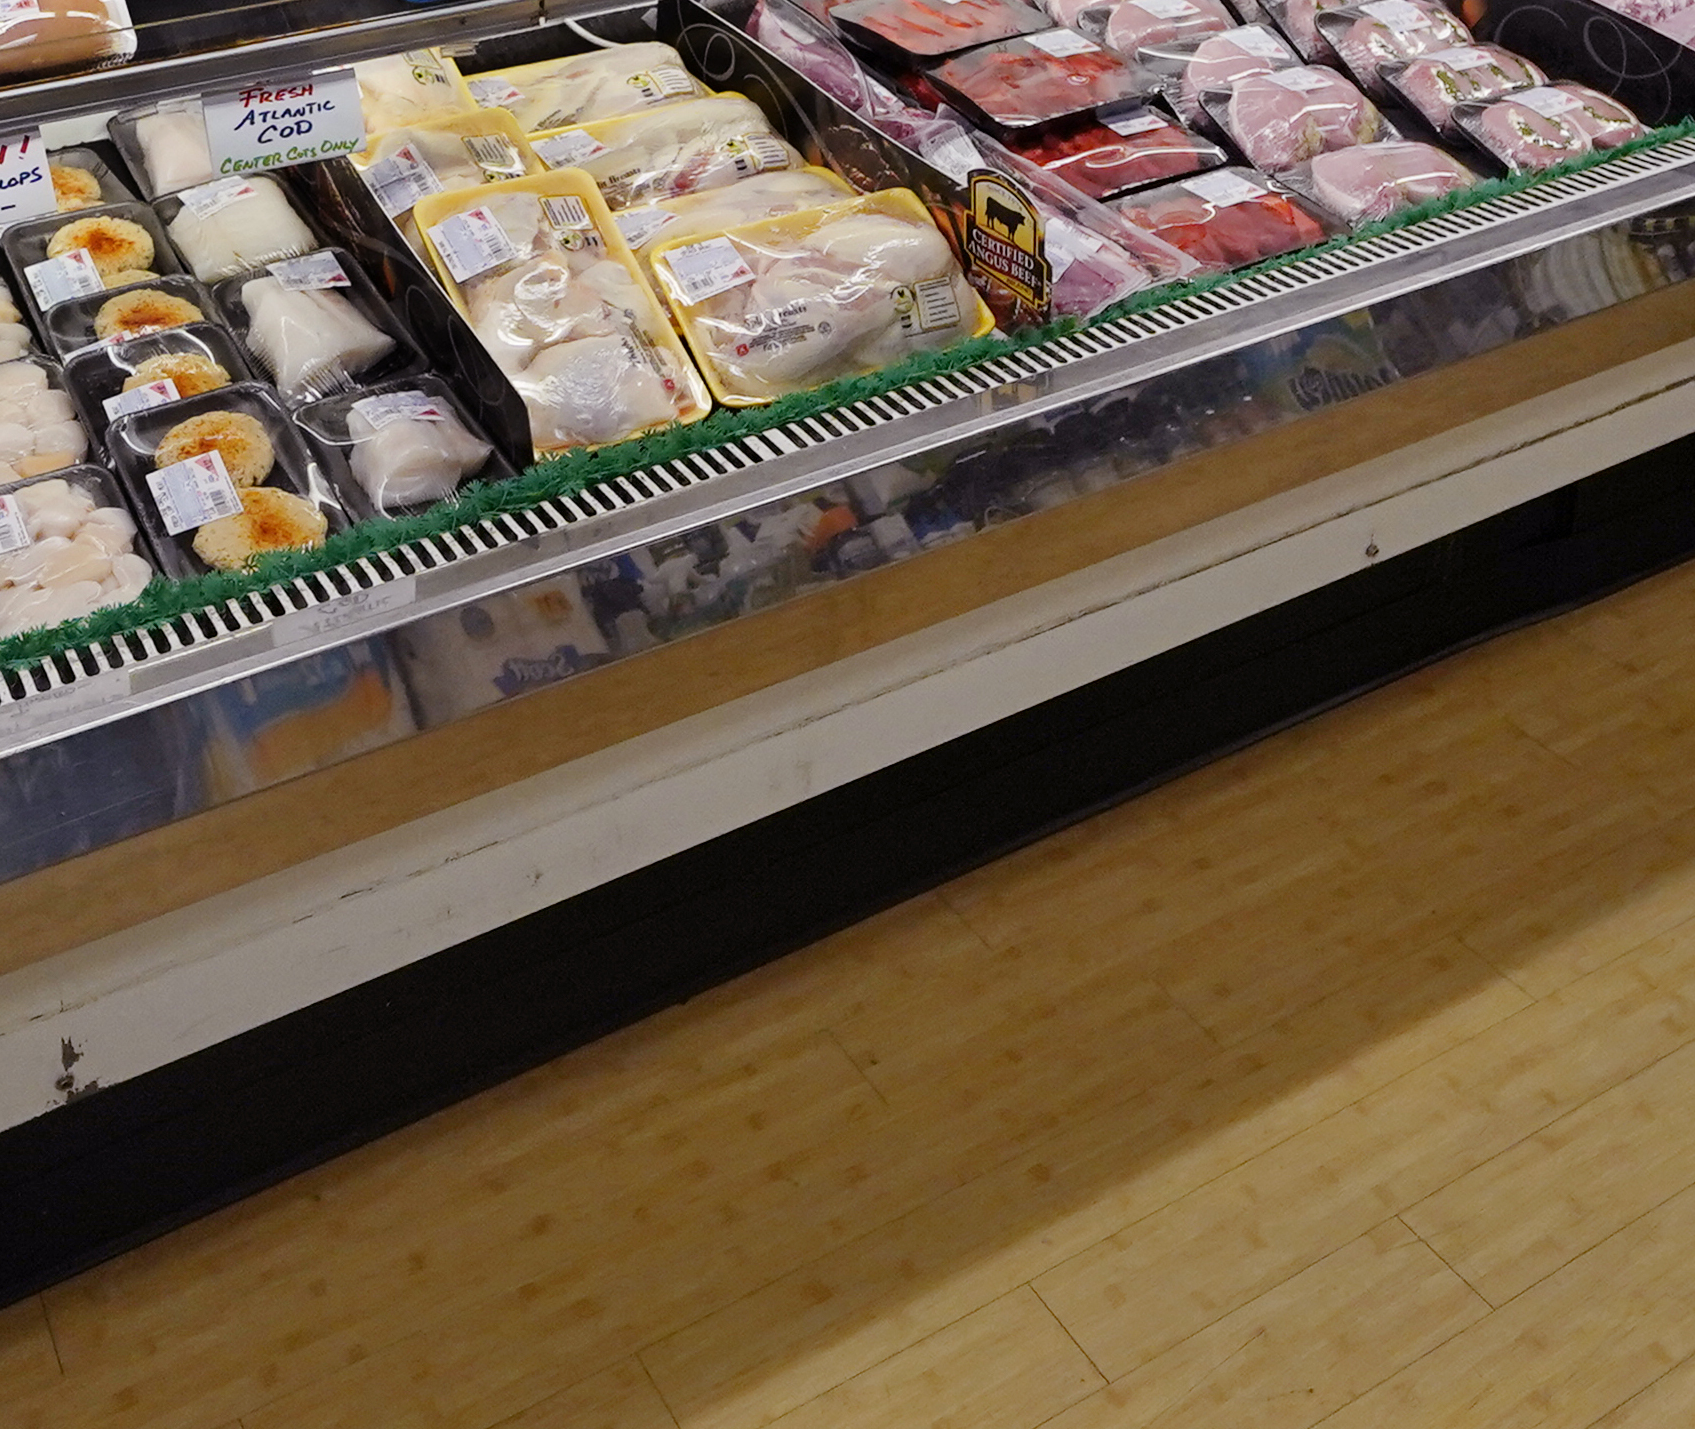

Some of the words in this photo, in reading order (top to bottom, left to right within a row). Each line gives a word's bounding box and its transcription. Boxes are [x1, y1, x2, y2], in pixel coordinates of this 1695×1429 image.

[239, 83, 314, 108] FRESH
[234, 100, 335, 131] ATLANTIC
[257, 120, 313, 144] COD
[220, 152, 282, 174] CENTER
[320, 137, 359, 153] ONLY
[968, 238, 1009, 271] ANGUS
[1011, 262, 1039, 288] BEEF
[972, 228, 1034, 270] CERTIFIED
